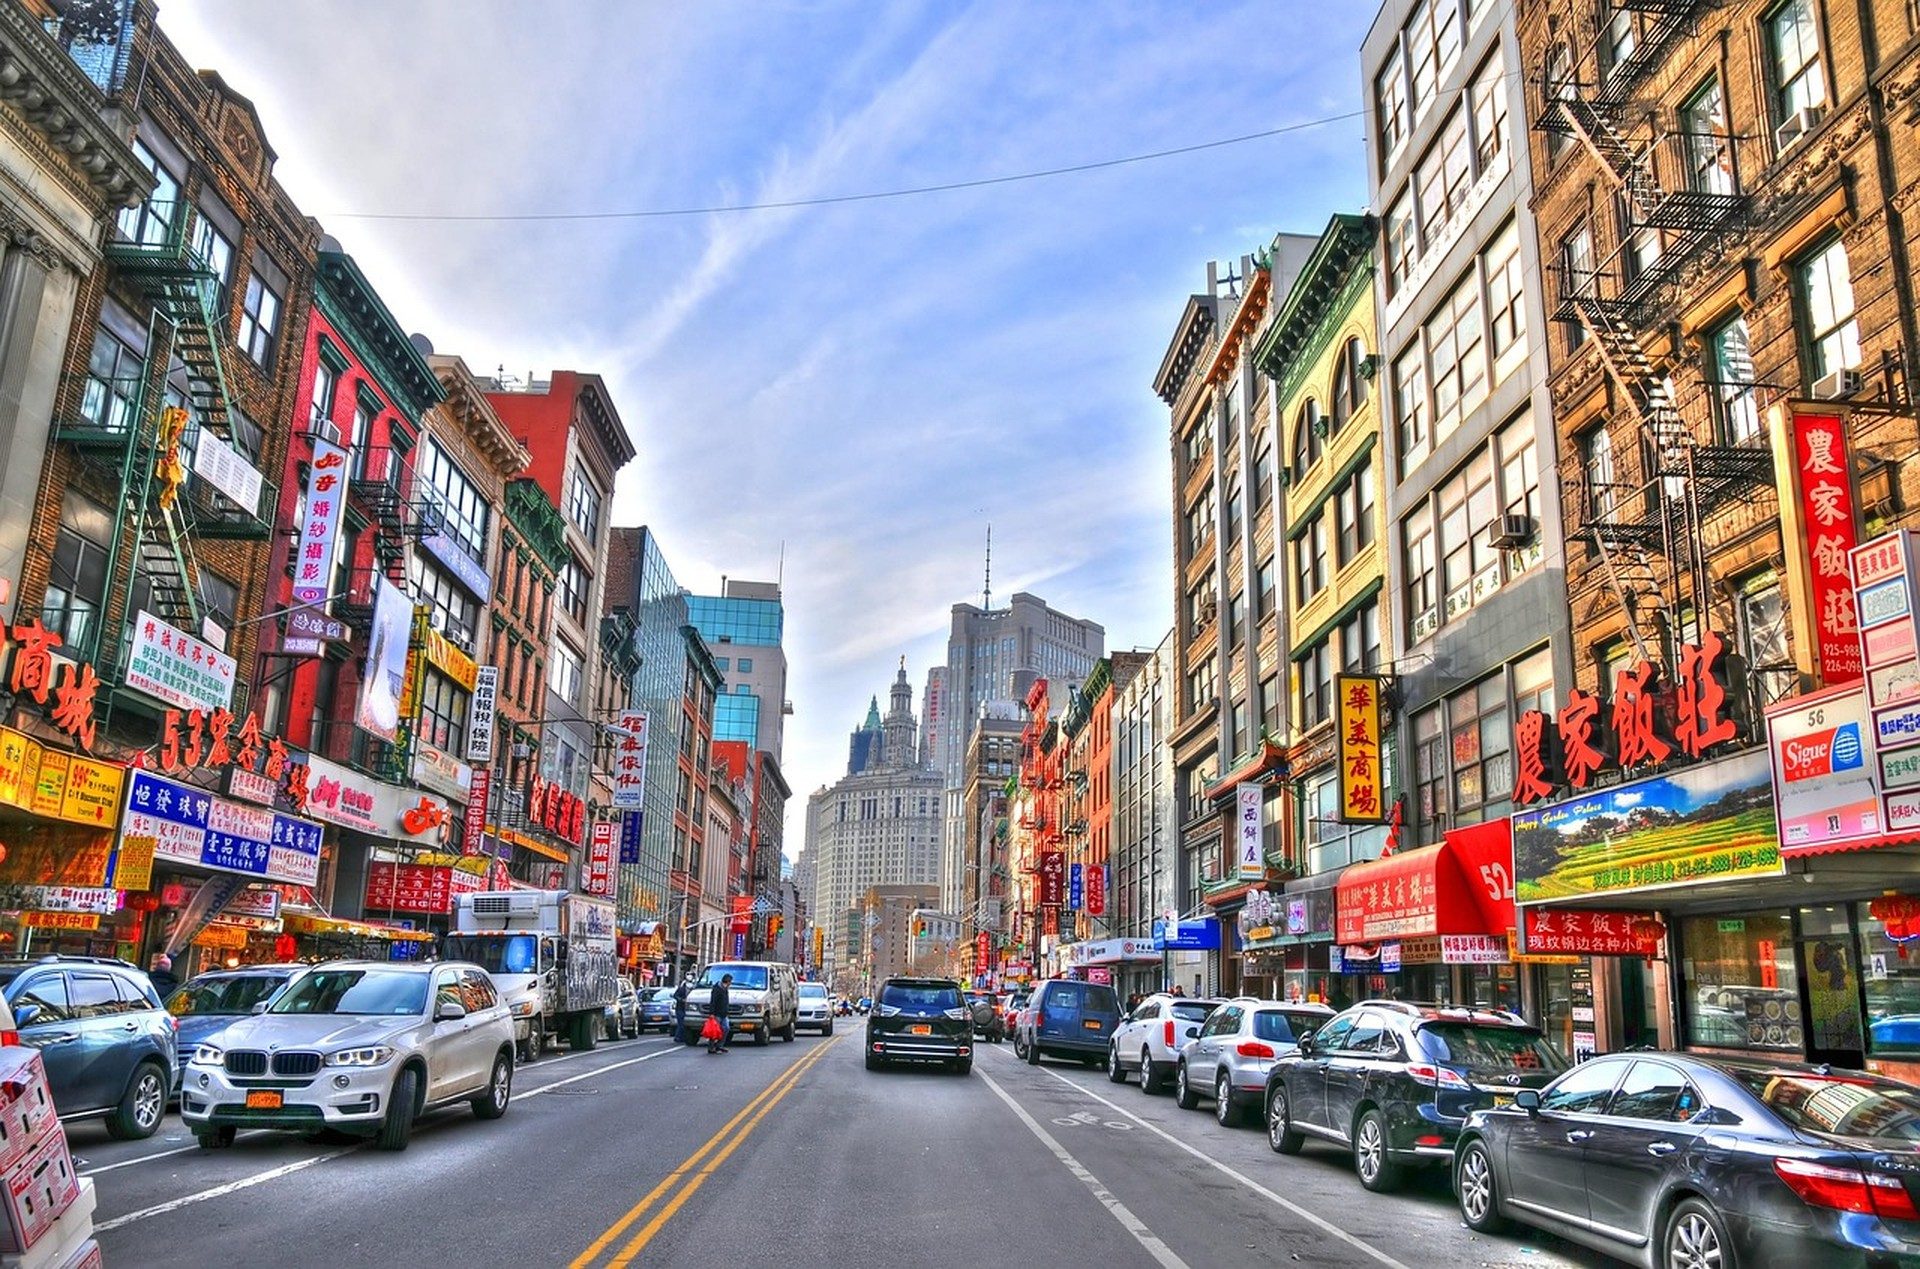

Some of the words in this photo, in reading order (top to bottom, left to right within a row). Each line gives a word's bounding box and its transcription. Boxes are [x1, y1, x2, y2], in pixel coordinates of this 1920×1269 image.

[1808, 709, 1825, 727] 56
[1345, 684, 1377, 815] 華美商場
[1785, 741, 1828, 770] Sigue
[1243, 808, 1258, 862] 西餅屋
[1480, 861, 1514, 901] 52
[1875, 957, 1885, 973] A
